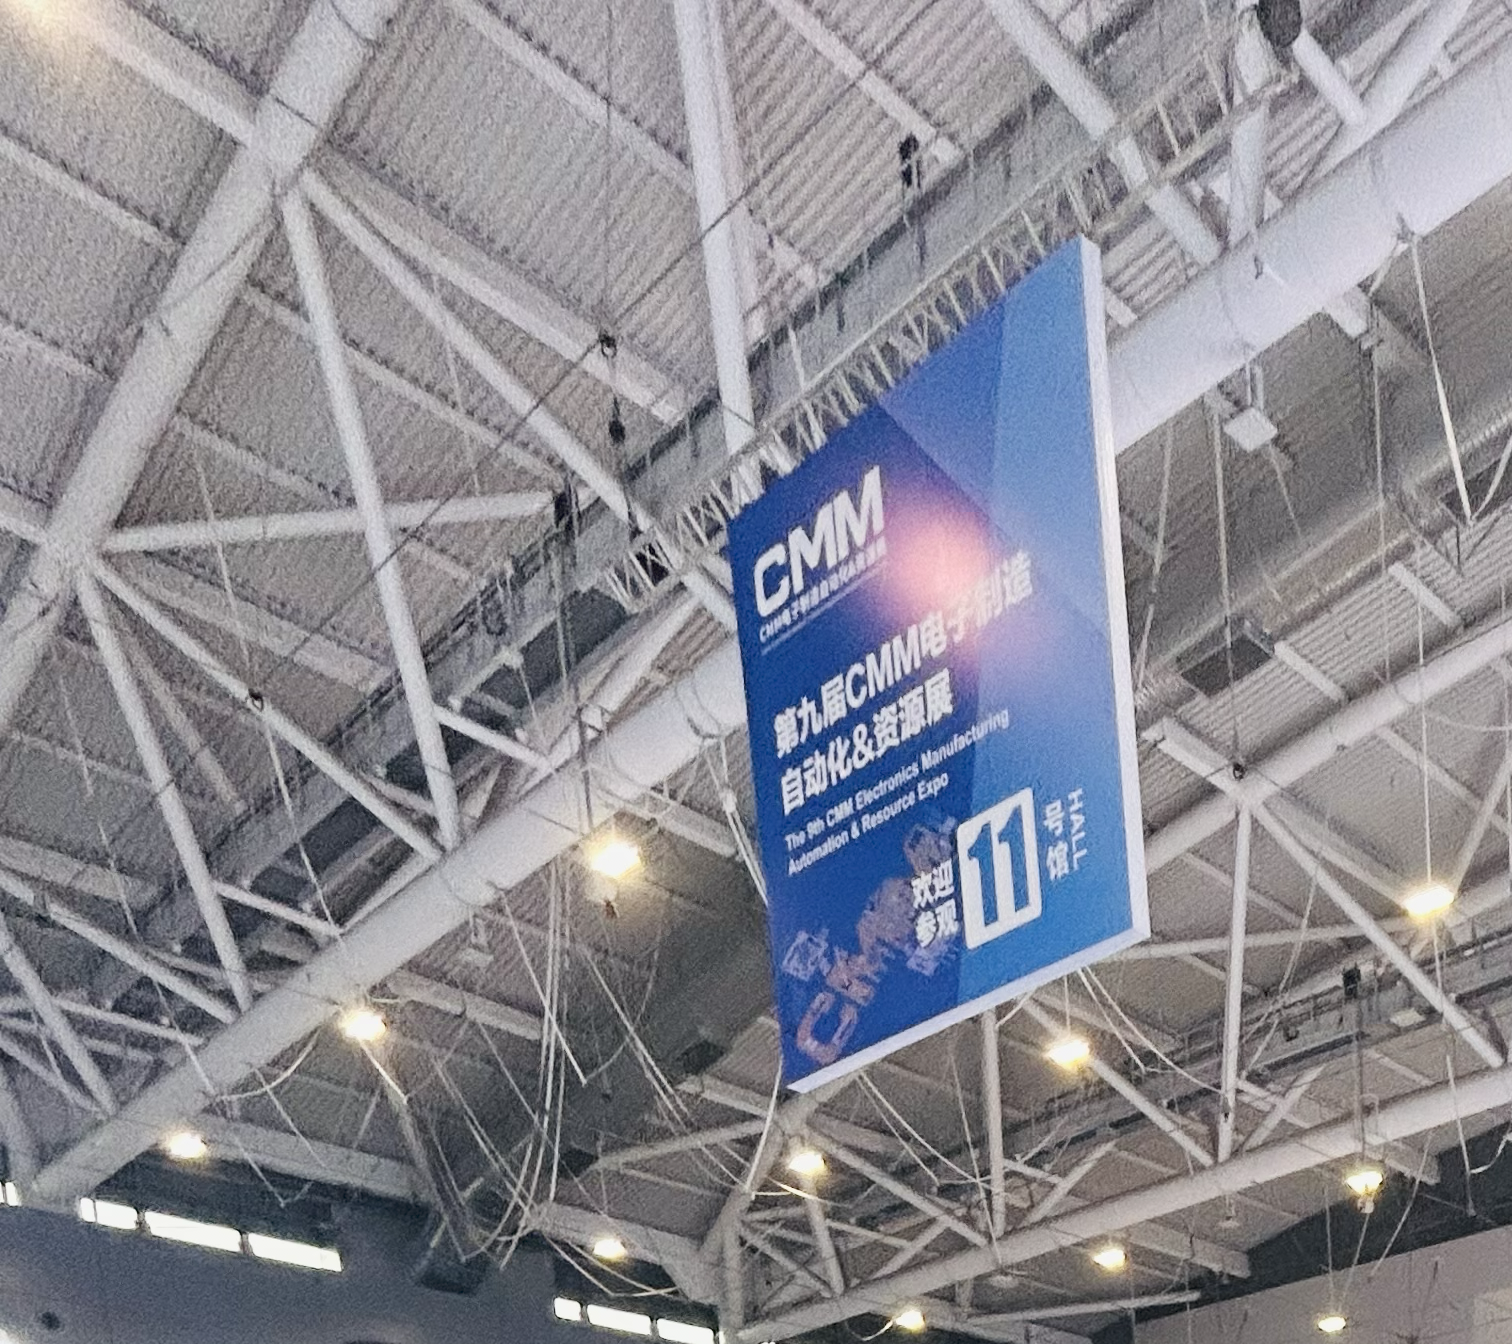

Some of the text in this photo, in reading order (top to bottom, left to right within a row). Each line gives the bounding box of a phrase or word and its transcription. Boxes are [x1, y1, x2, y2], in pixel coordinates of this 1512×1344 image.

[753, 464, 885, 617] CMM
[781, 668, 953, 816] 自动化&资源展
[785, 709, 1009, 851] The 9th CMM Electronics Manufacturing
[788, 830, 849, 876] Automation
[861, 790, 916, 832] Resource
[917, 773, 949, 801] Expo
[967, 804, 1030, 927] 11
[1068, 787, 1088, 871] HALL
[910, 858, 955, 908] 欢迎
[914, 898, 960, 948] 参观
